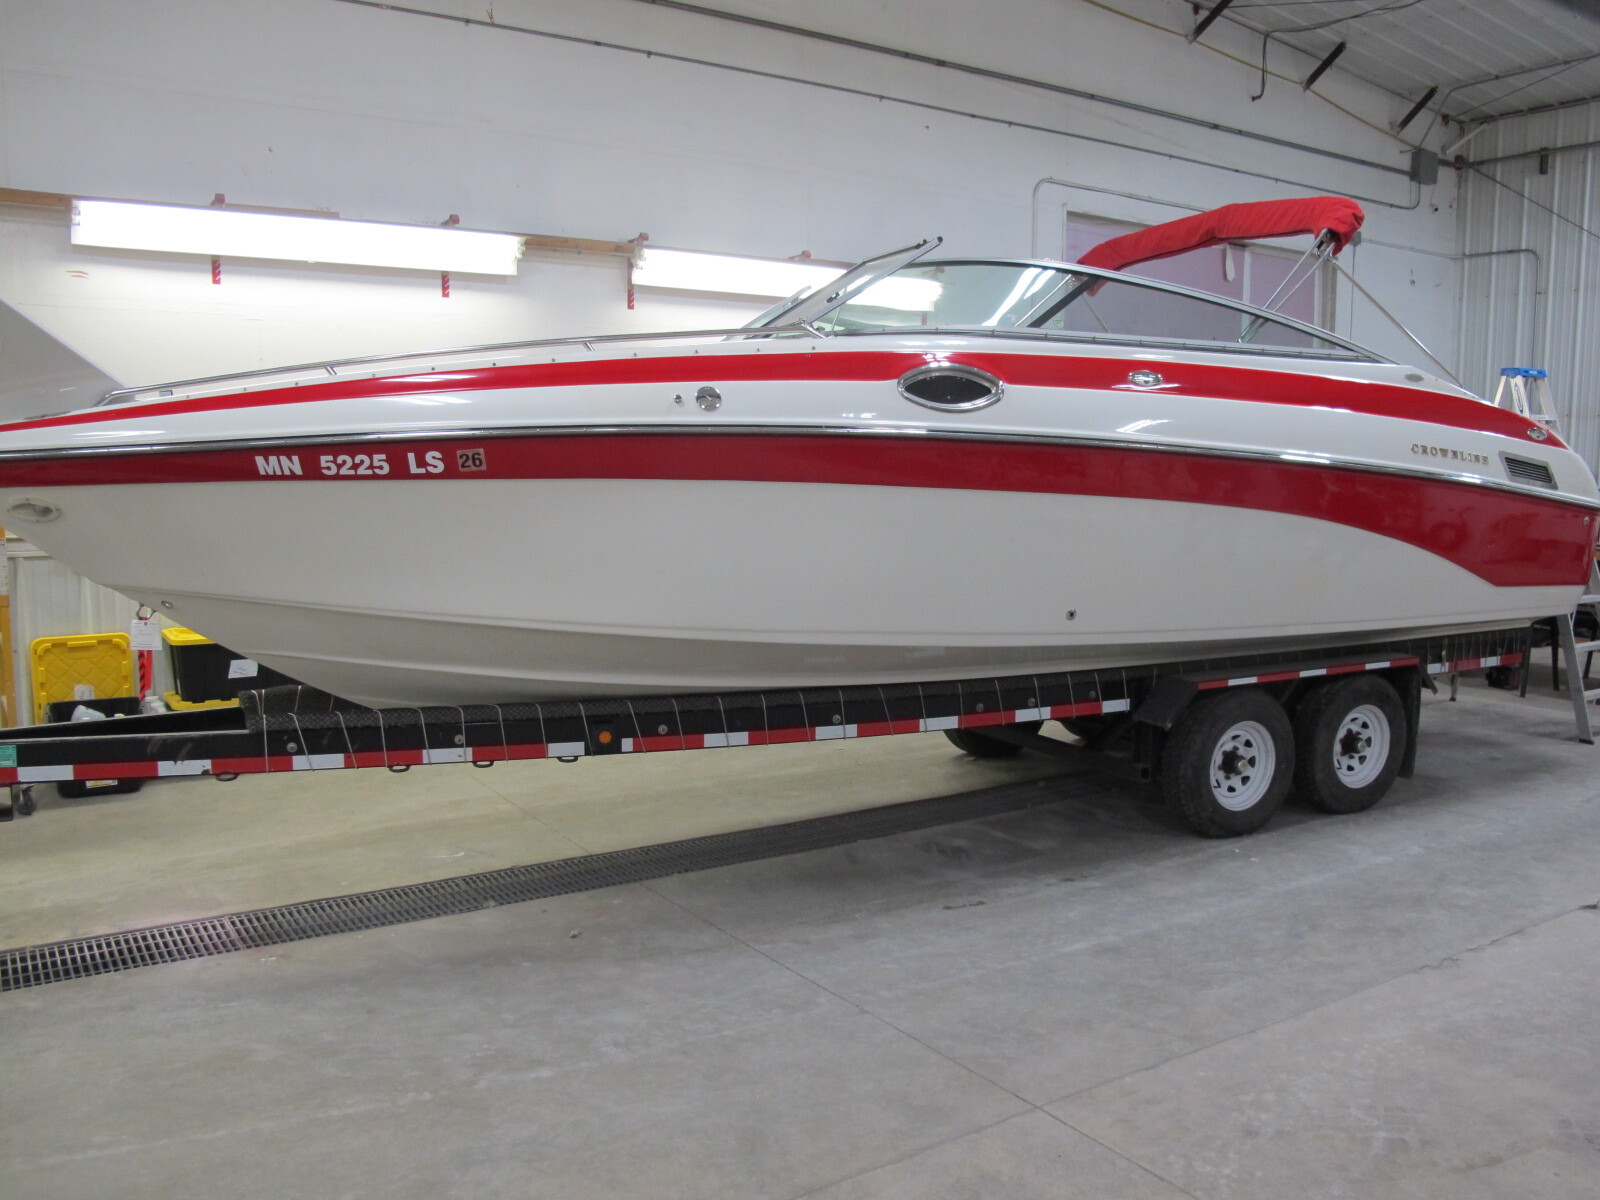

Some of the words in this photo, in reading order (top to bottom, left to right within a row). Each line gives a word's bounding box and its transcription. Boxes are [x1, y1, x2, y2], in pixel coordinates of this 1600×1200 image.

[254, 455, 303, 476] MN
[319, 453, 390, 475] 5225
[407, 450, 445, 474] LS
[458, 451, 483, 469] 26
[1411, 443, 1489, 465] CROWNLINE
